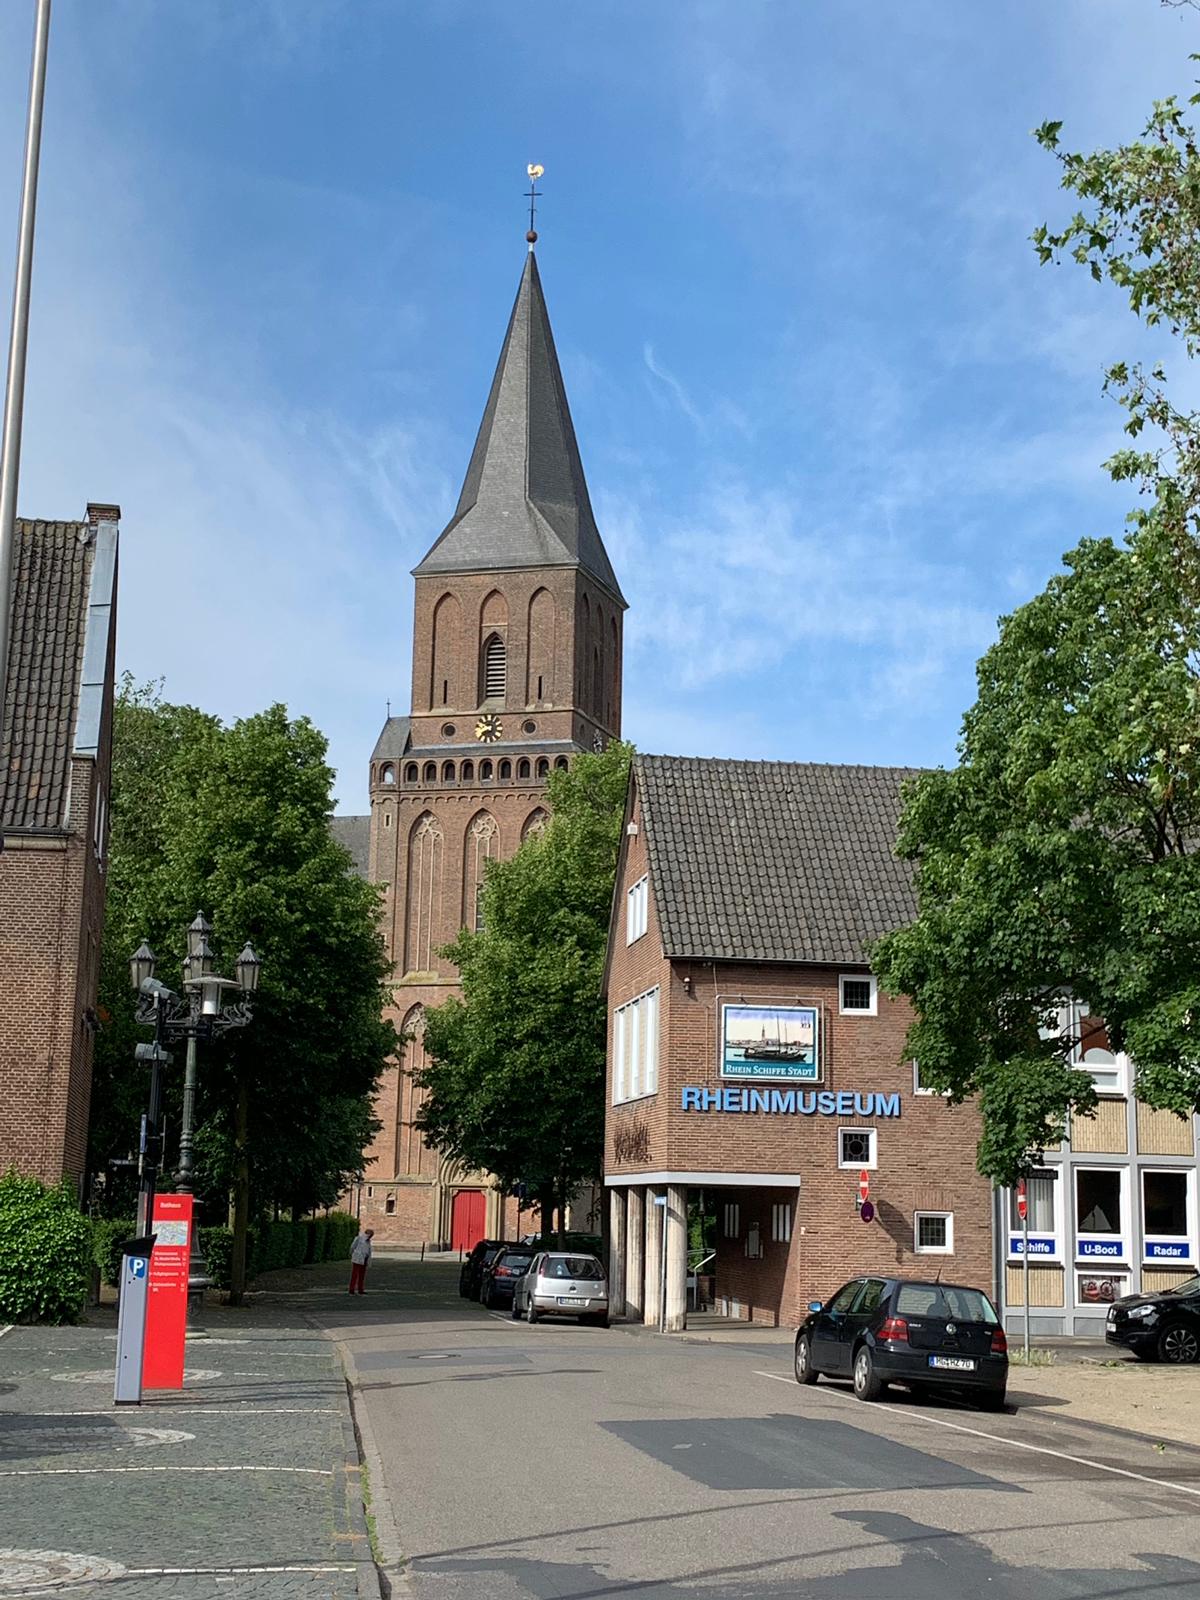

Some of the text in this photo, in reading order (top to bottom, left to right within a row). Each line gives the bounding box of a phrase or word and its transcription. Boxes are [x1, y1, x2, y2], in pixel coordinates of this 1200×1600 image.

[725, 1064, 813, 1077] RHEIN SCHIFFE STADT
[682, 1087, 900, 1116] RHEINMUSEUM
[1017, 1242, 1050, 1253] Shiffe
[1084, 1244, 1118, 1255] U-Boot
[1153, 1246, 1181, 1256] Radar
[133, 1259, 144, 1275] P
